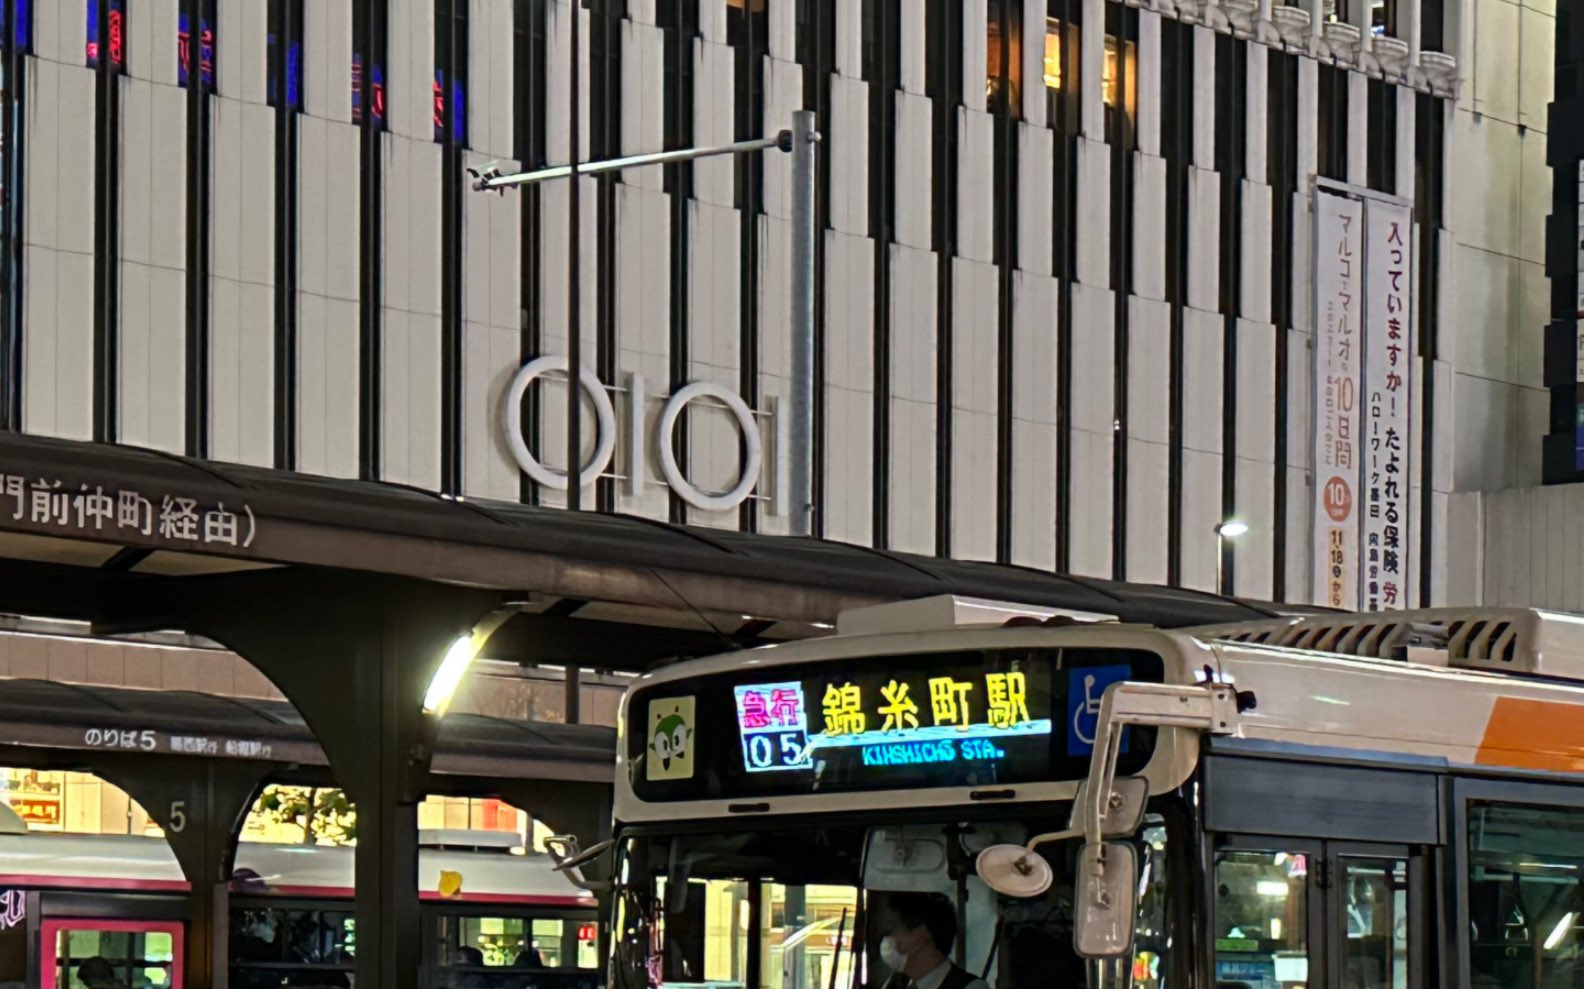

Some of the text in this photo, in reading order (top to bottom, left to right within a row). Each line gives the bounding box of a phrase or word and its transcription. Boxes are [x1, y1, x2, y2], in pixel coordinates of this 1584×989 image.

[742, 688, 800, 728] 急行
[821, 671, 1031, 736] 錦糸町駅
[750, 733, 803, 767] 05
[169, 802, 185, 832] 5
